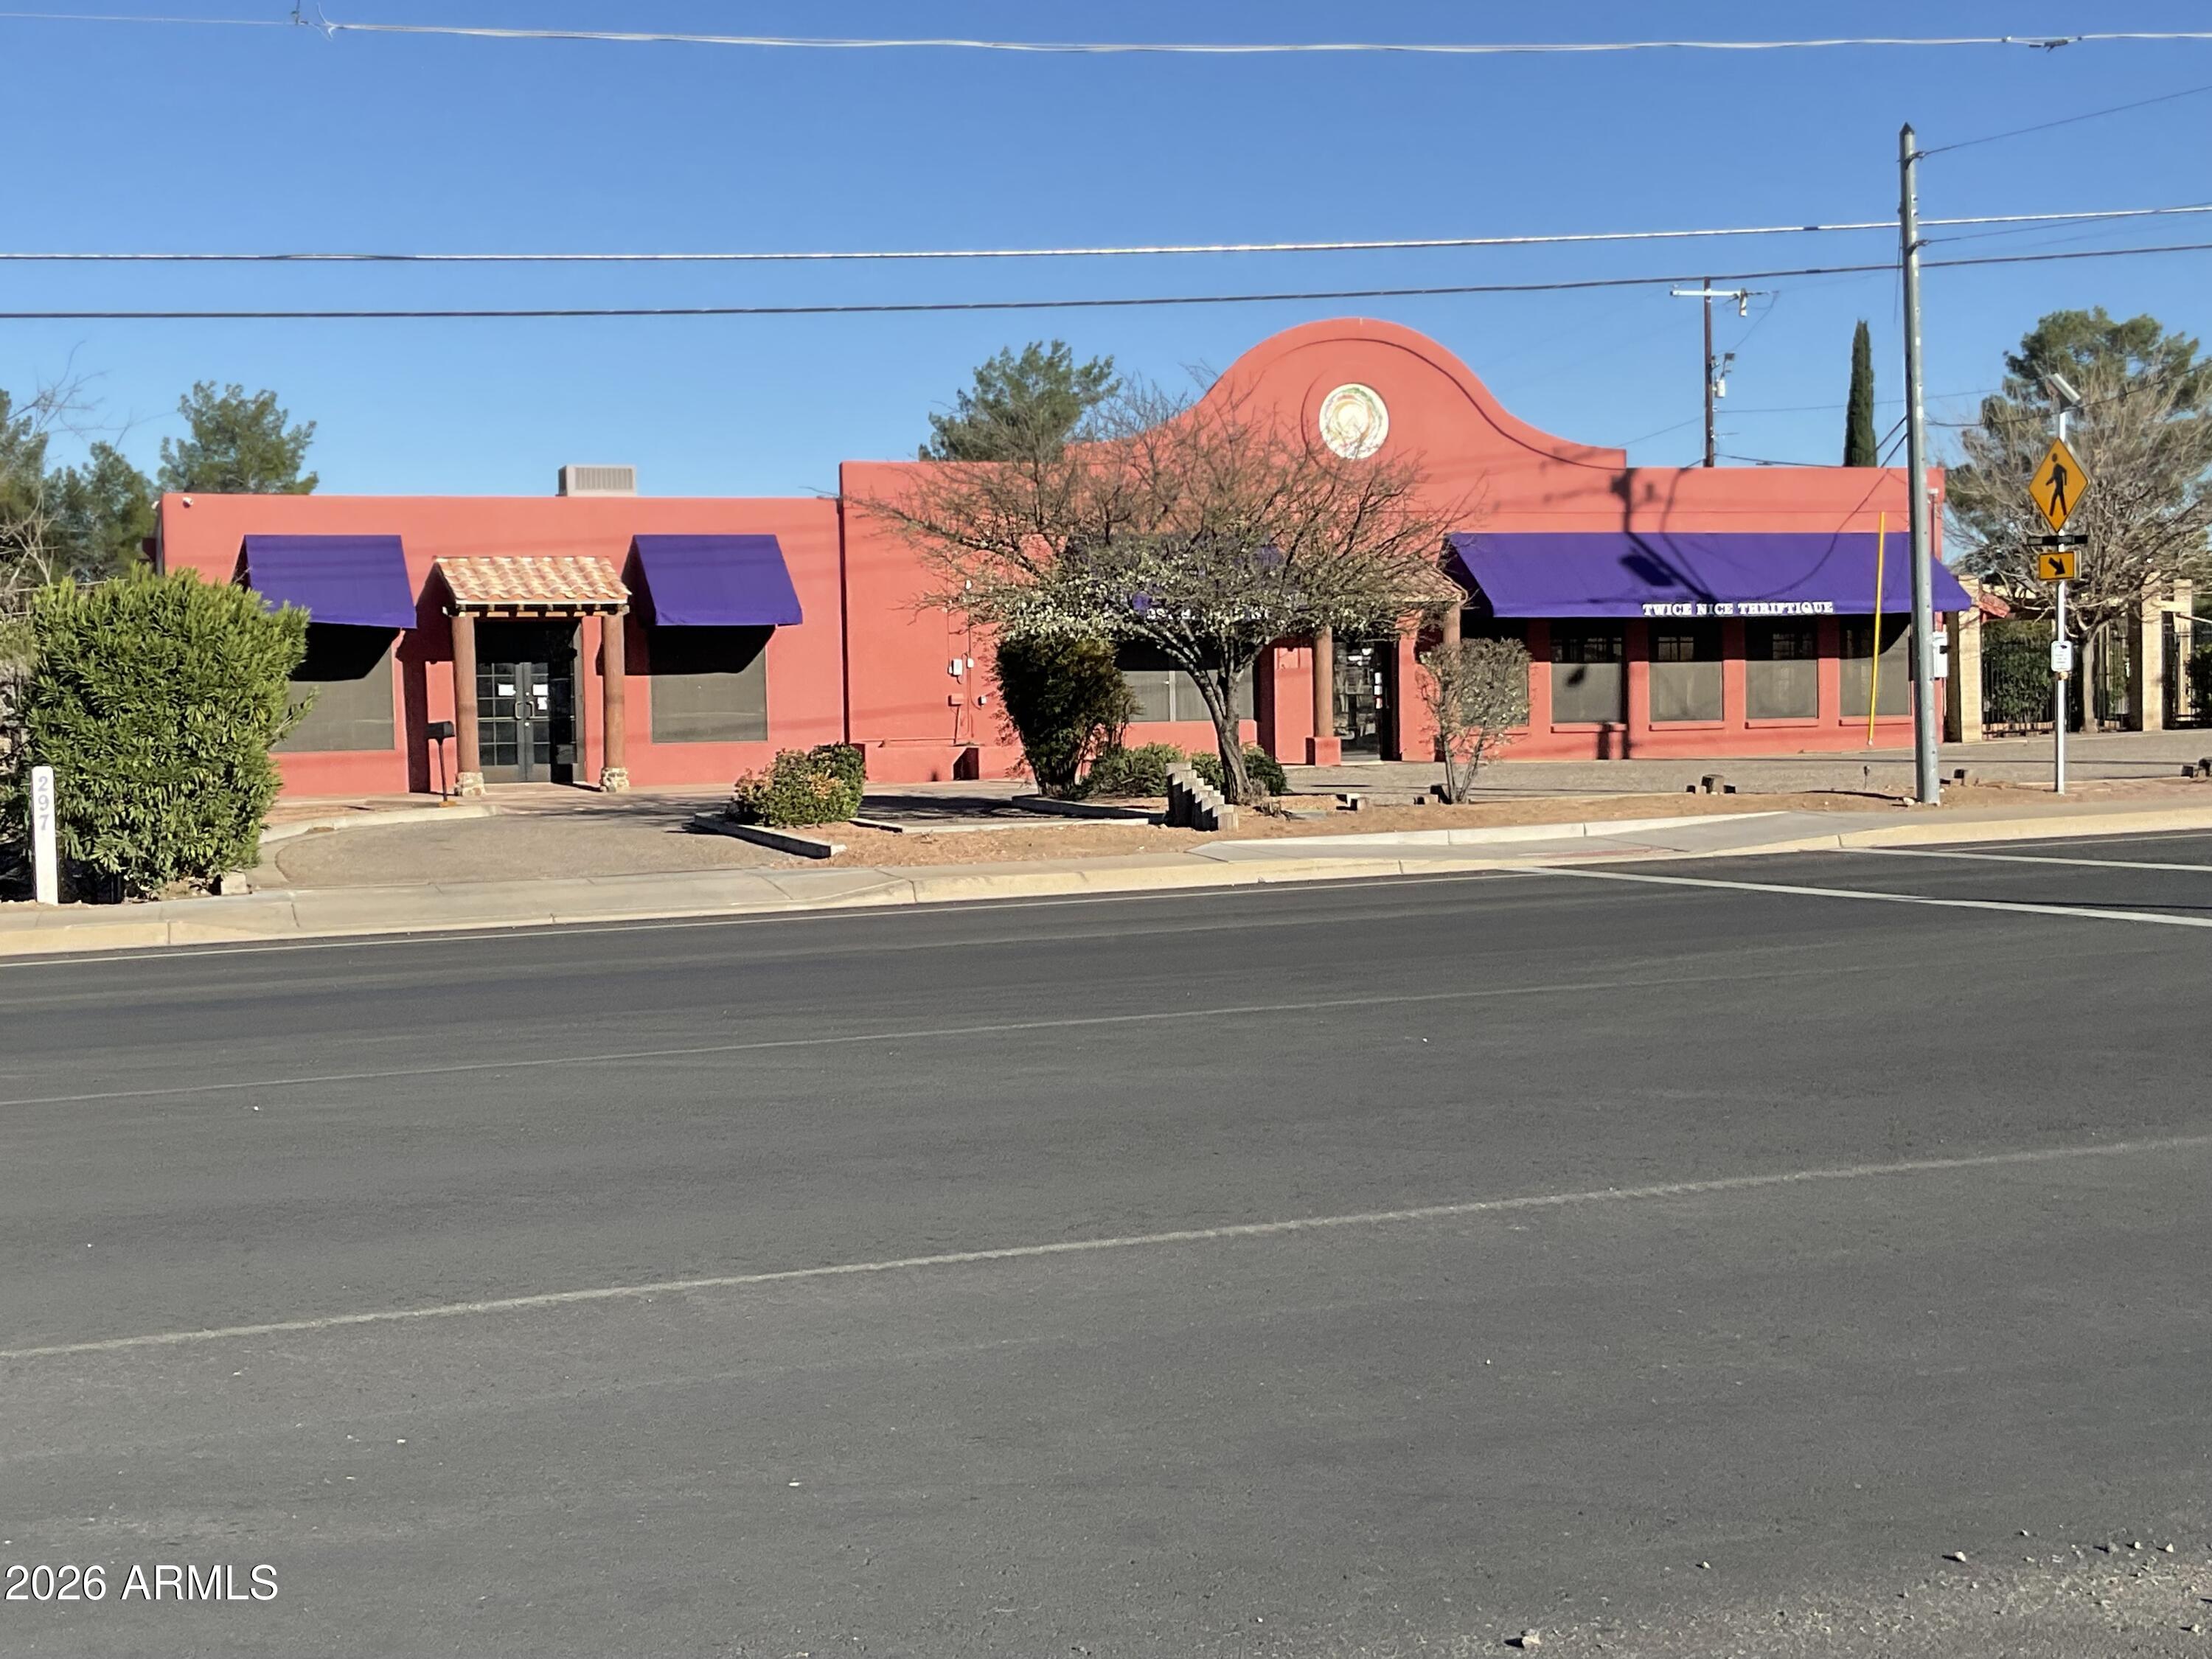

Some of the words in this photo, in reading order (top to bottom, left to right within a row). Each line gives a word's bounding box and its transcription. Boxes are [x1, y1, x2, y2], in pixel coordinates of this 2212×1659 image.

[1643, 604, 1691, 616] TWICE
[1696, 603, 1733, 615] NICE
[1738, 602, 1833, 614] THRIFTIQUE
[38, 776, 49, 831] 297
